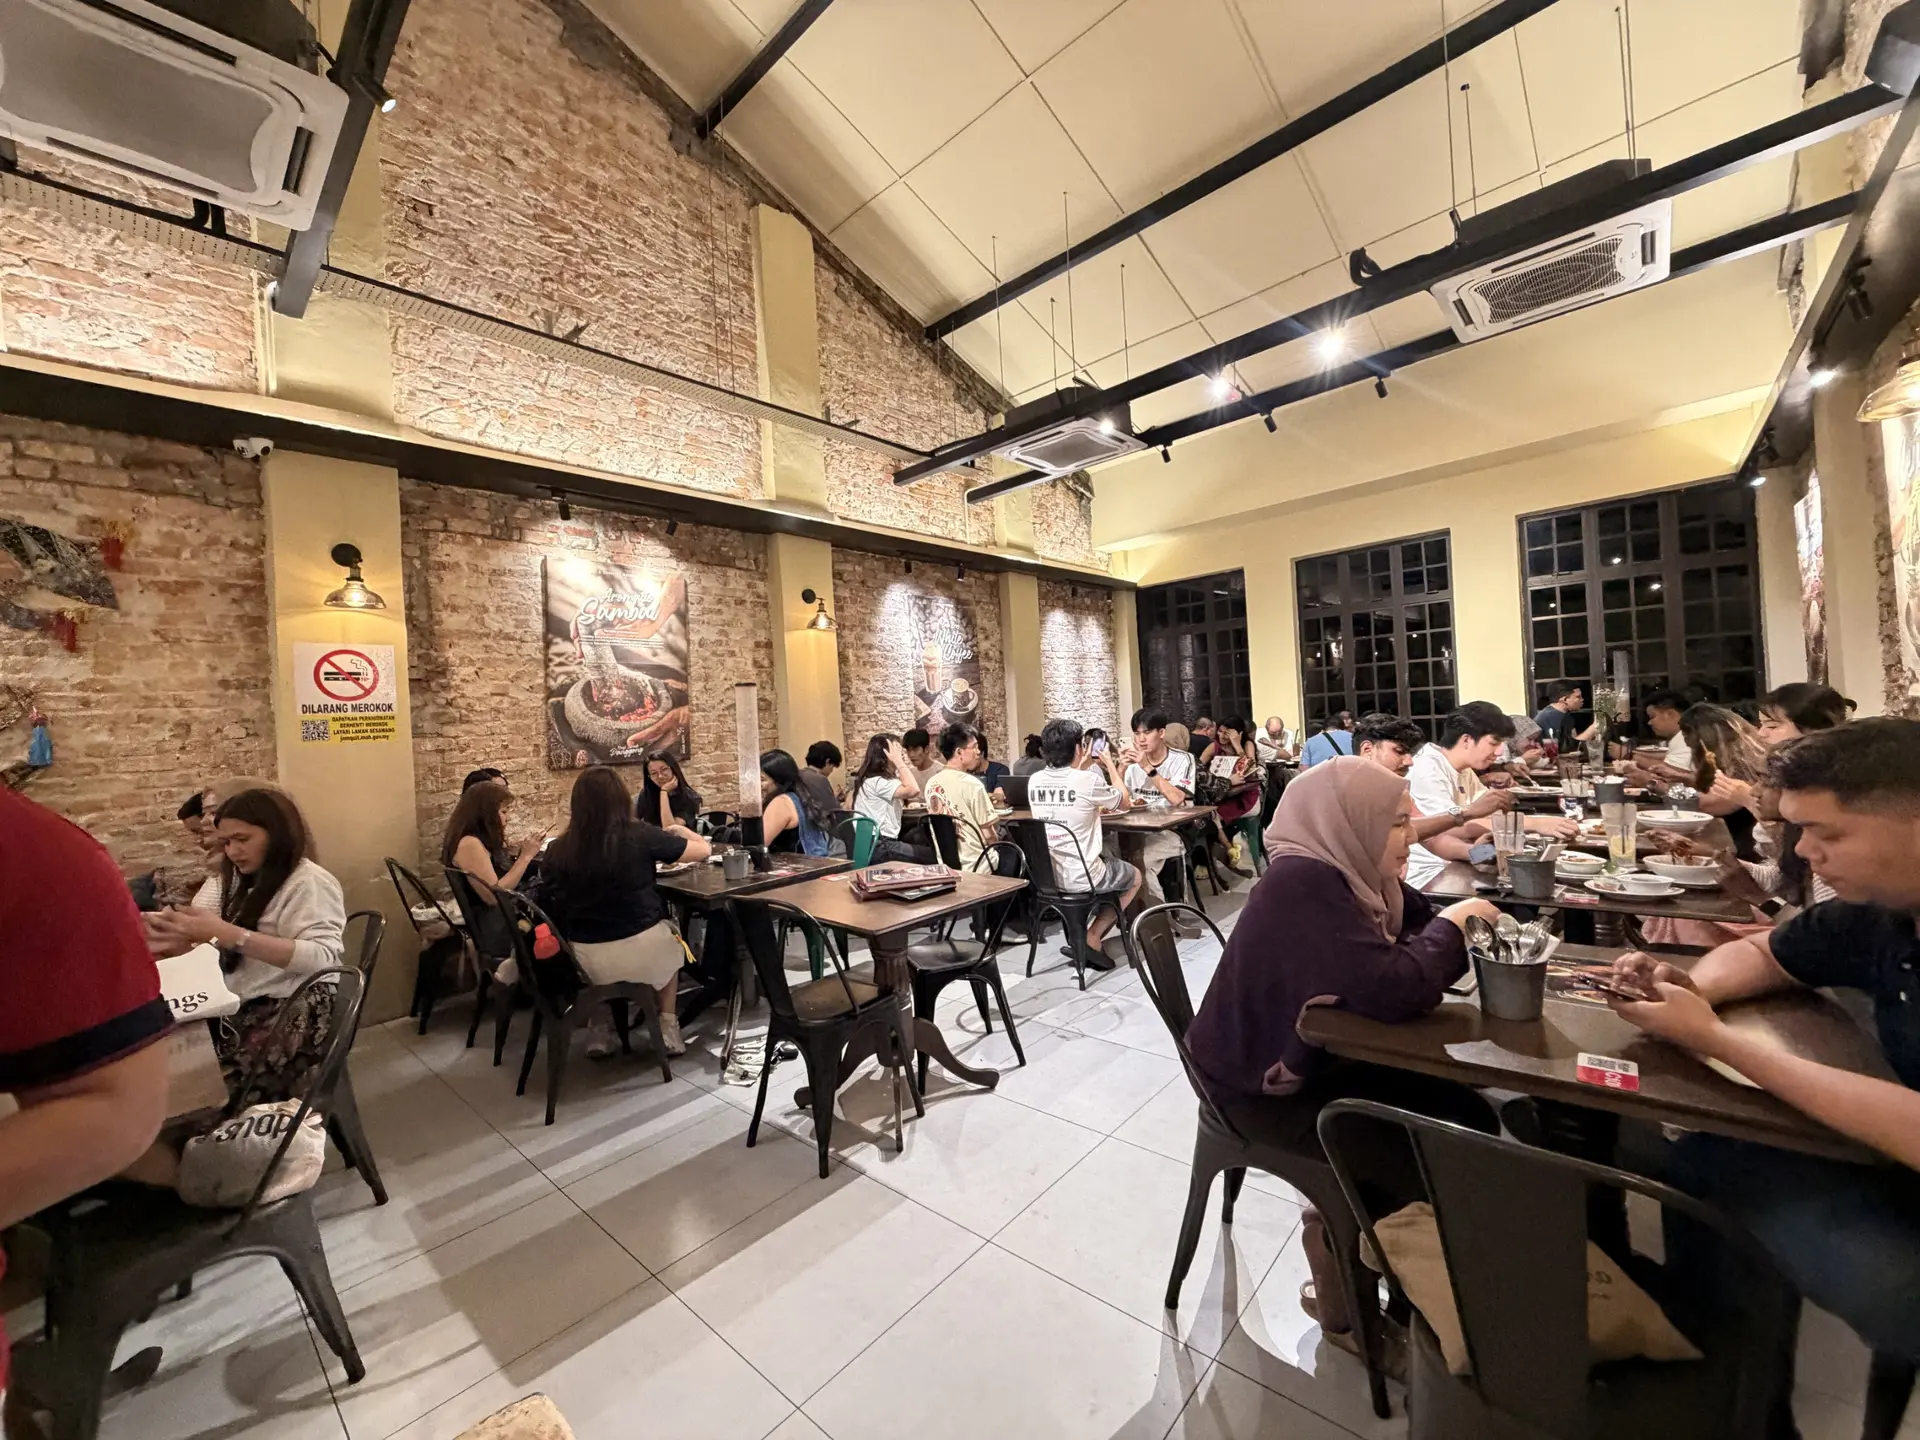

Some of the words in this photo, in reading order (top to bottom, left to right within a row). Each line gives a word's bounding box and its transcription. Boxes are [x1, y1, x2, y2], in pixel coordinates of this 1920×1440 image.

[943, 644, 972, 663] Coffee
[302, 703, 348, 714] DILARANG
[351, 703, 394, 713] MEROKOK
[1030, 789, 1077, 802] UMYEC
